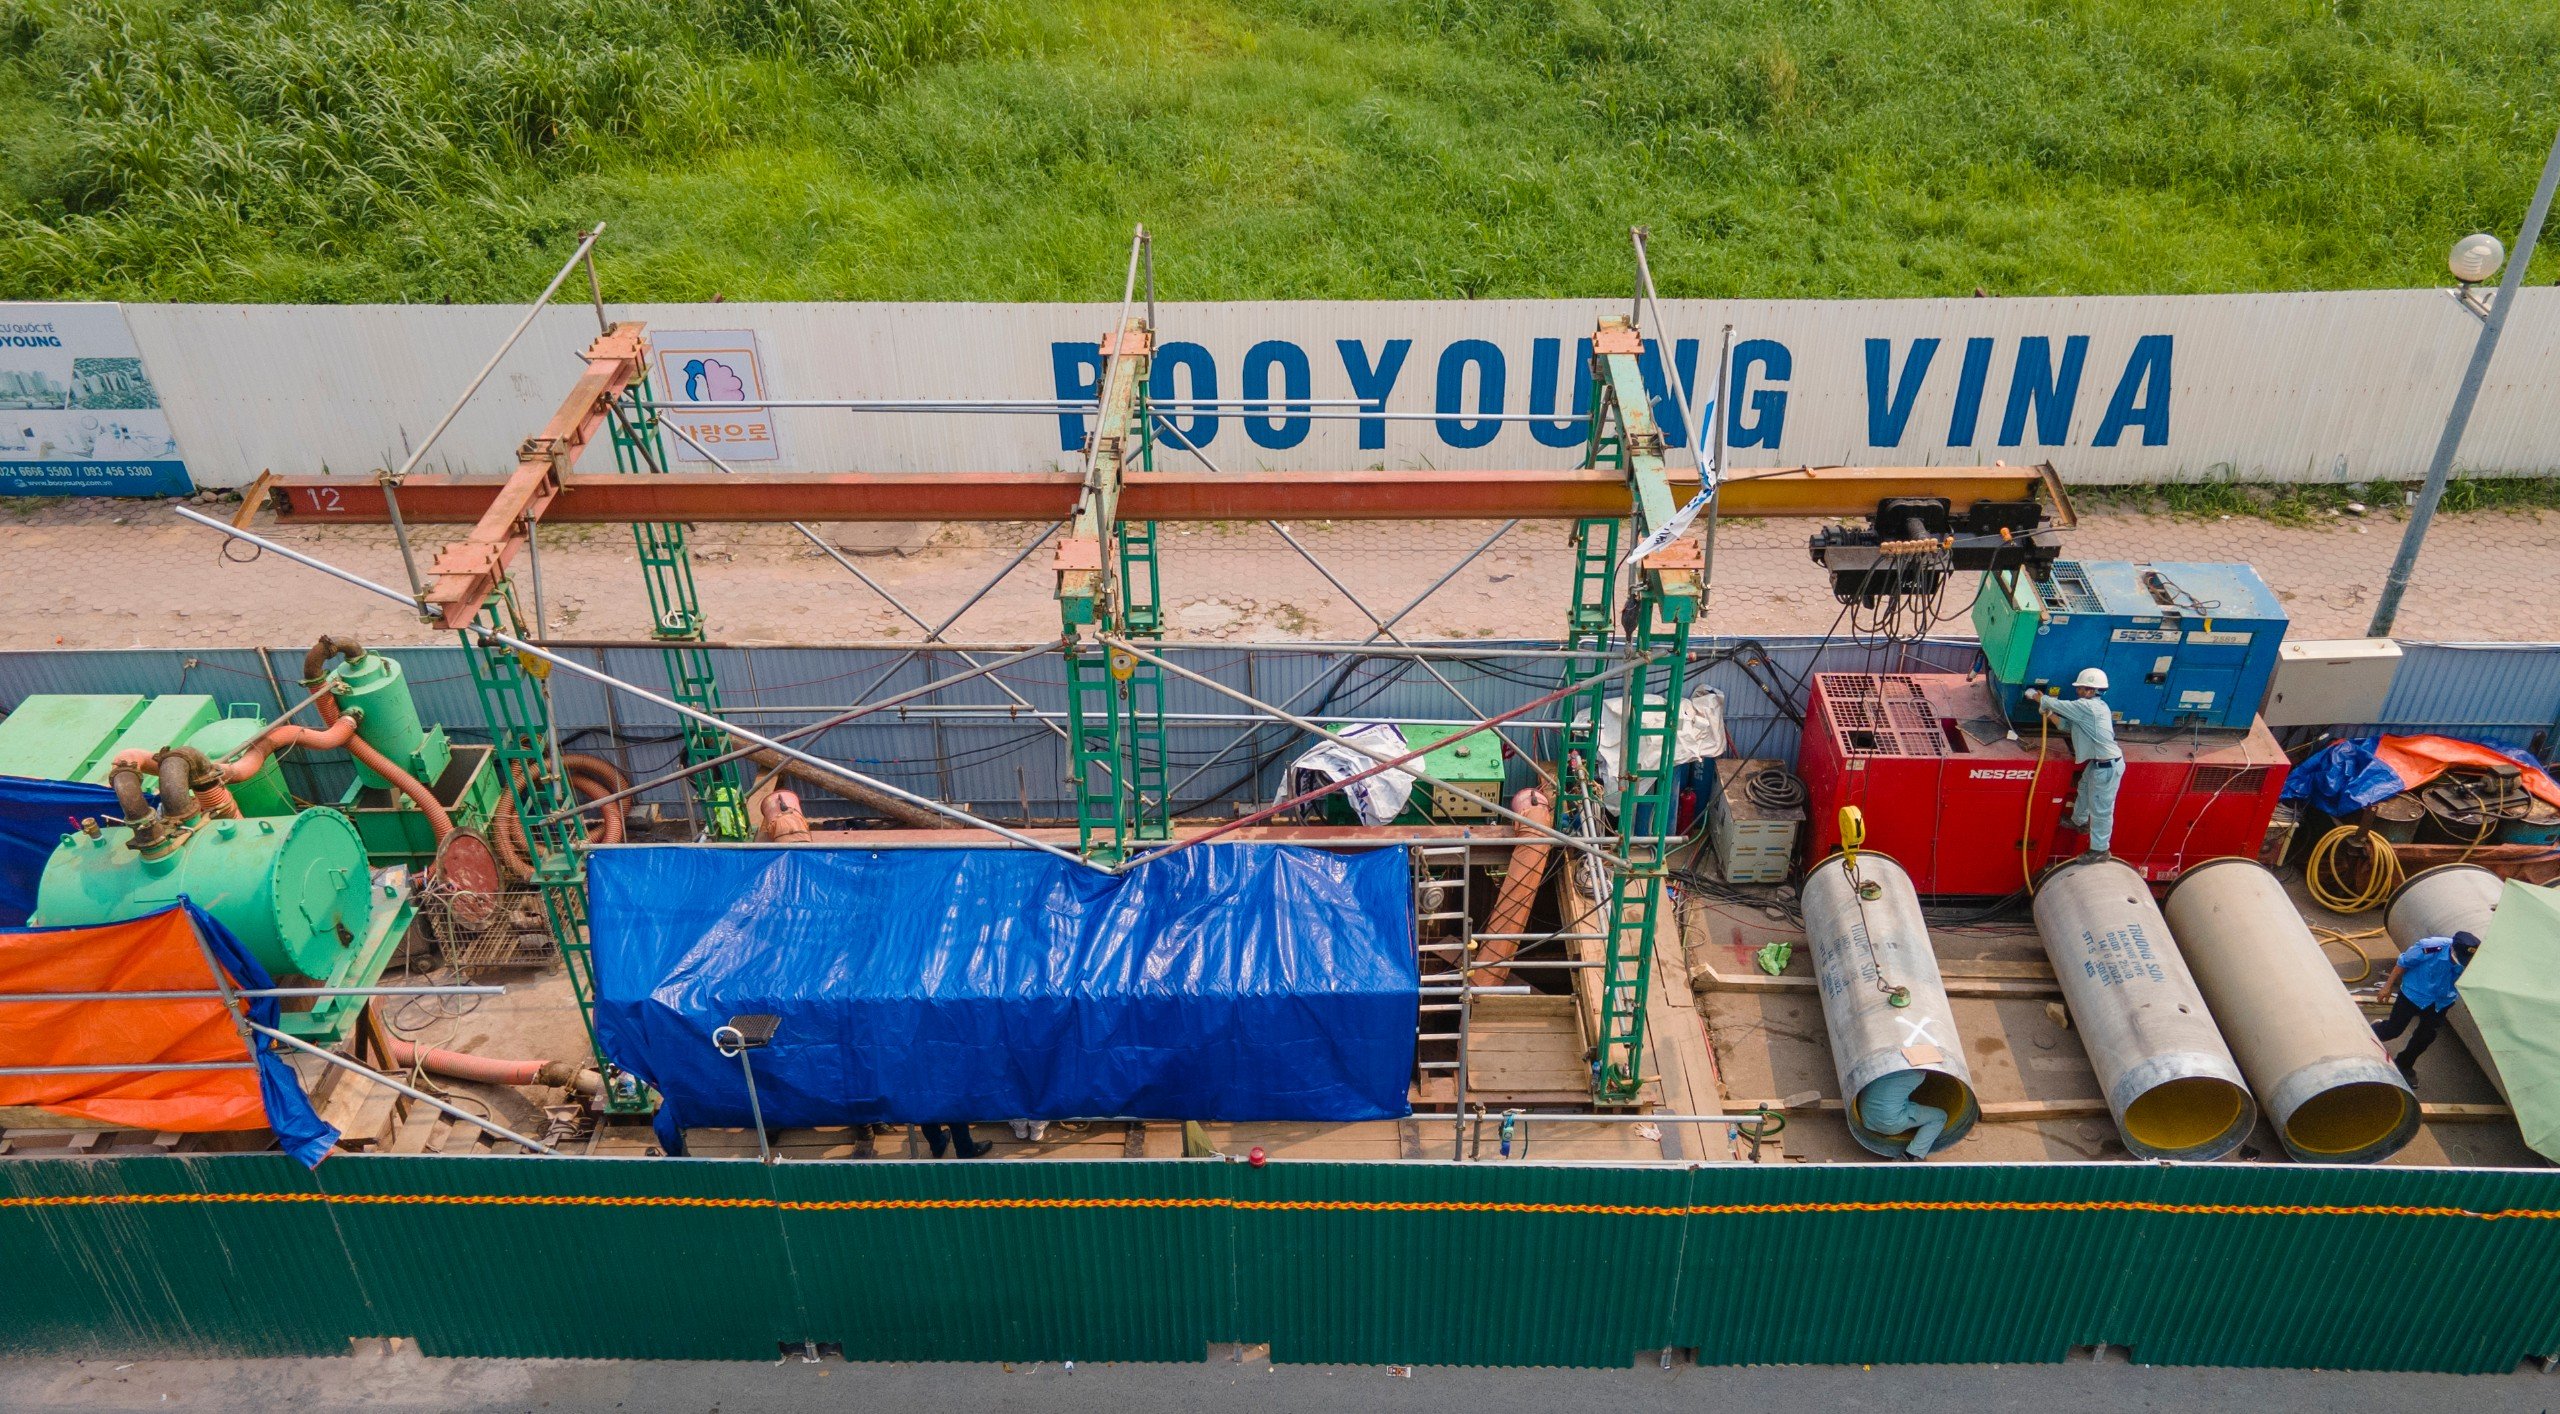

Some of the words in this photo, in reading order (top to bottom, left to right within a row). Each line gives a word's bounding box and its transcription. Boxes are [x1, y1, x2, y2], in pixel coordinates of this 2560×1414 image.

[1865, 335, 2174, 447] VINA
[19, 466, 45, 477] 6666
[47, 466, 72, 477] 5500
[83, 466, 104, 477] 093
[106, 466, 125, 477] 456
[127, 466, 153, 477] 5300
[306, 487, 345, 511] 12
[2145, 963, 2165, 982] SON
